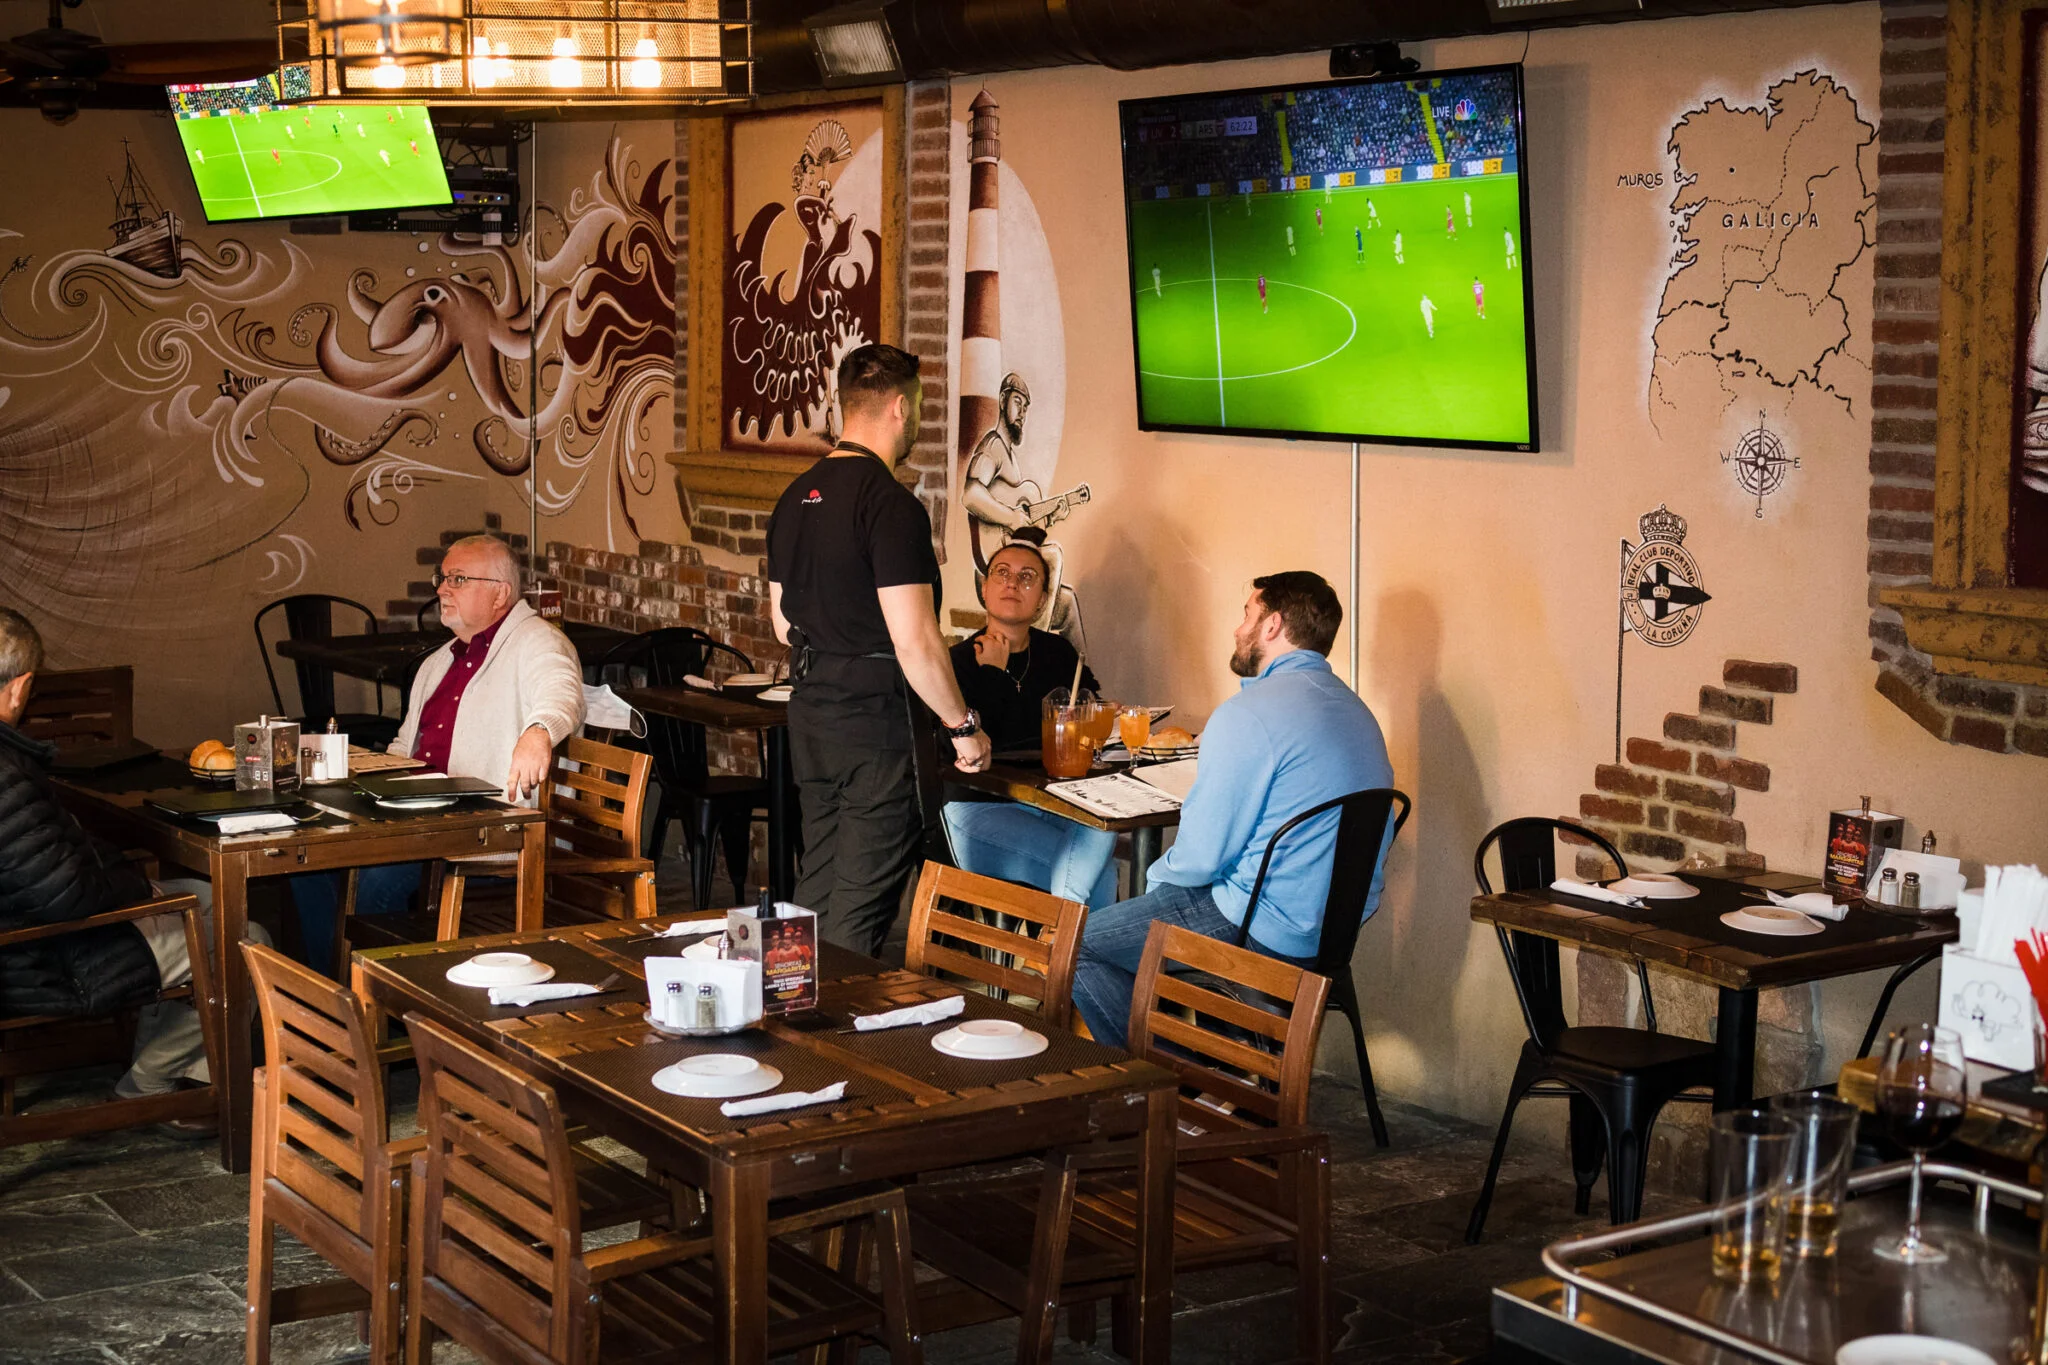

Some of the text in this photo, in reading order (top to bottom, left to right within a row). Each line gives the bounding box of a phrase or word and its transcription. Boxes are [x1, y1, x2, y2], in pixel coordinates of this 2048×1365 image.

[1432, 106, 1450, 118] LIVE
[1230, 121, 1253, 132] 62:22
[1617, 173, 1664, 189] MUROS
[1722, 213, 1819, 228] GALICIA
[1759, 408, 1766, 418] N
[1720, 449, 1731, 464] W
[1794, 457, 1801, 468] E
[1755, 508, 1763, 518] S
[1627, 546, 1696, 585] REAL CLUB DEPORTIVO
[541, 606, 562, 617] TAPA
[1646, 614, 1693, 641] LA CORUÑA
[766, 964, 811, 976] MARGARITAS
